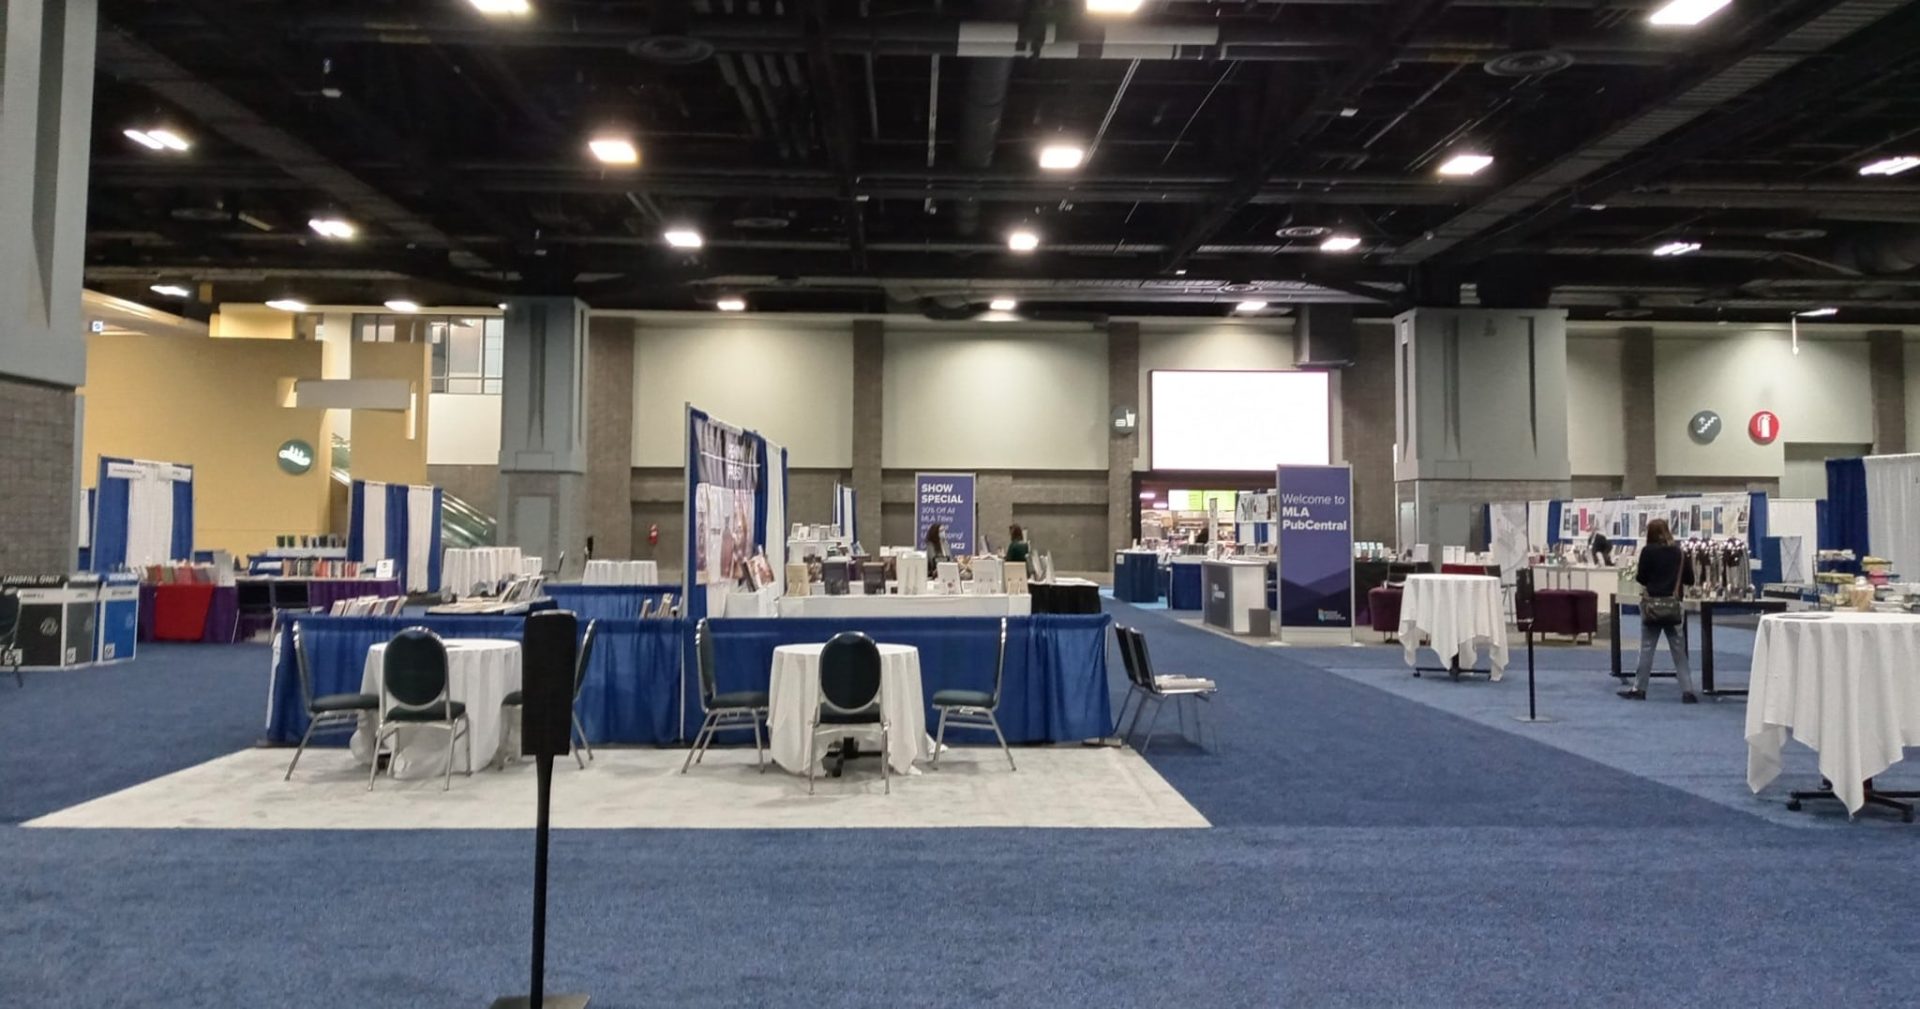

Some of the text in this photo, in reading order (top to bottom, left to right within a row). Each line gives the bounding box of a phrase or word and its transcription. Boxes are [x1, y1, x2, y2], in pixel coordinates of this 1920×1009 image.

[921, 483, 953, 493] SHOW
[921, 495, 964, 504] SPECIAL
[1282, 493, 1345, 505] Welcome to
[1282, 506, 1310, 517] MLA
[1282, 519, 1347, 531] PubCentral
[950, 542, 965, 550] M22
[39, 574, 61, 584] ONLY
